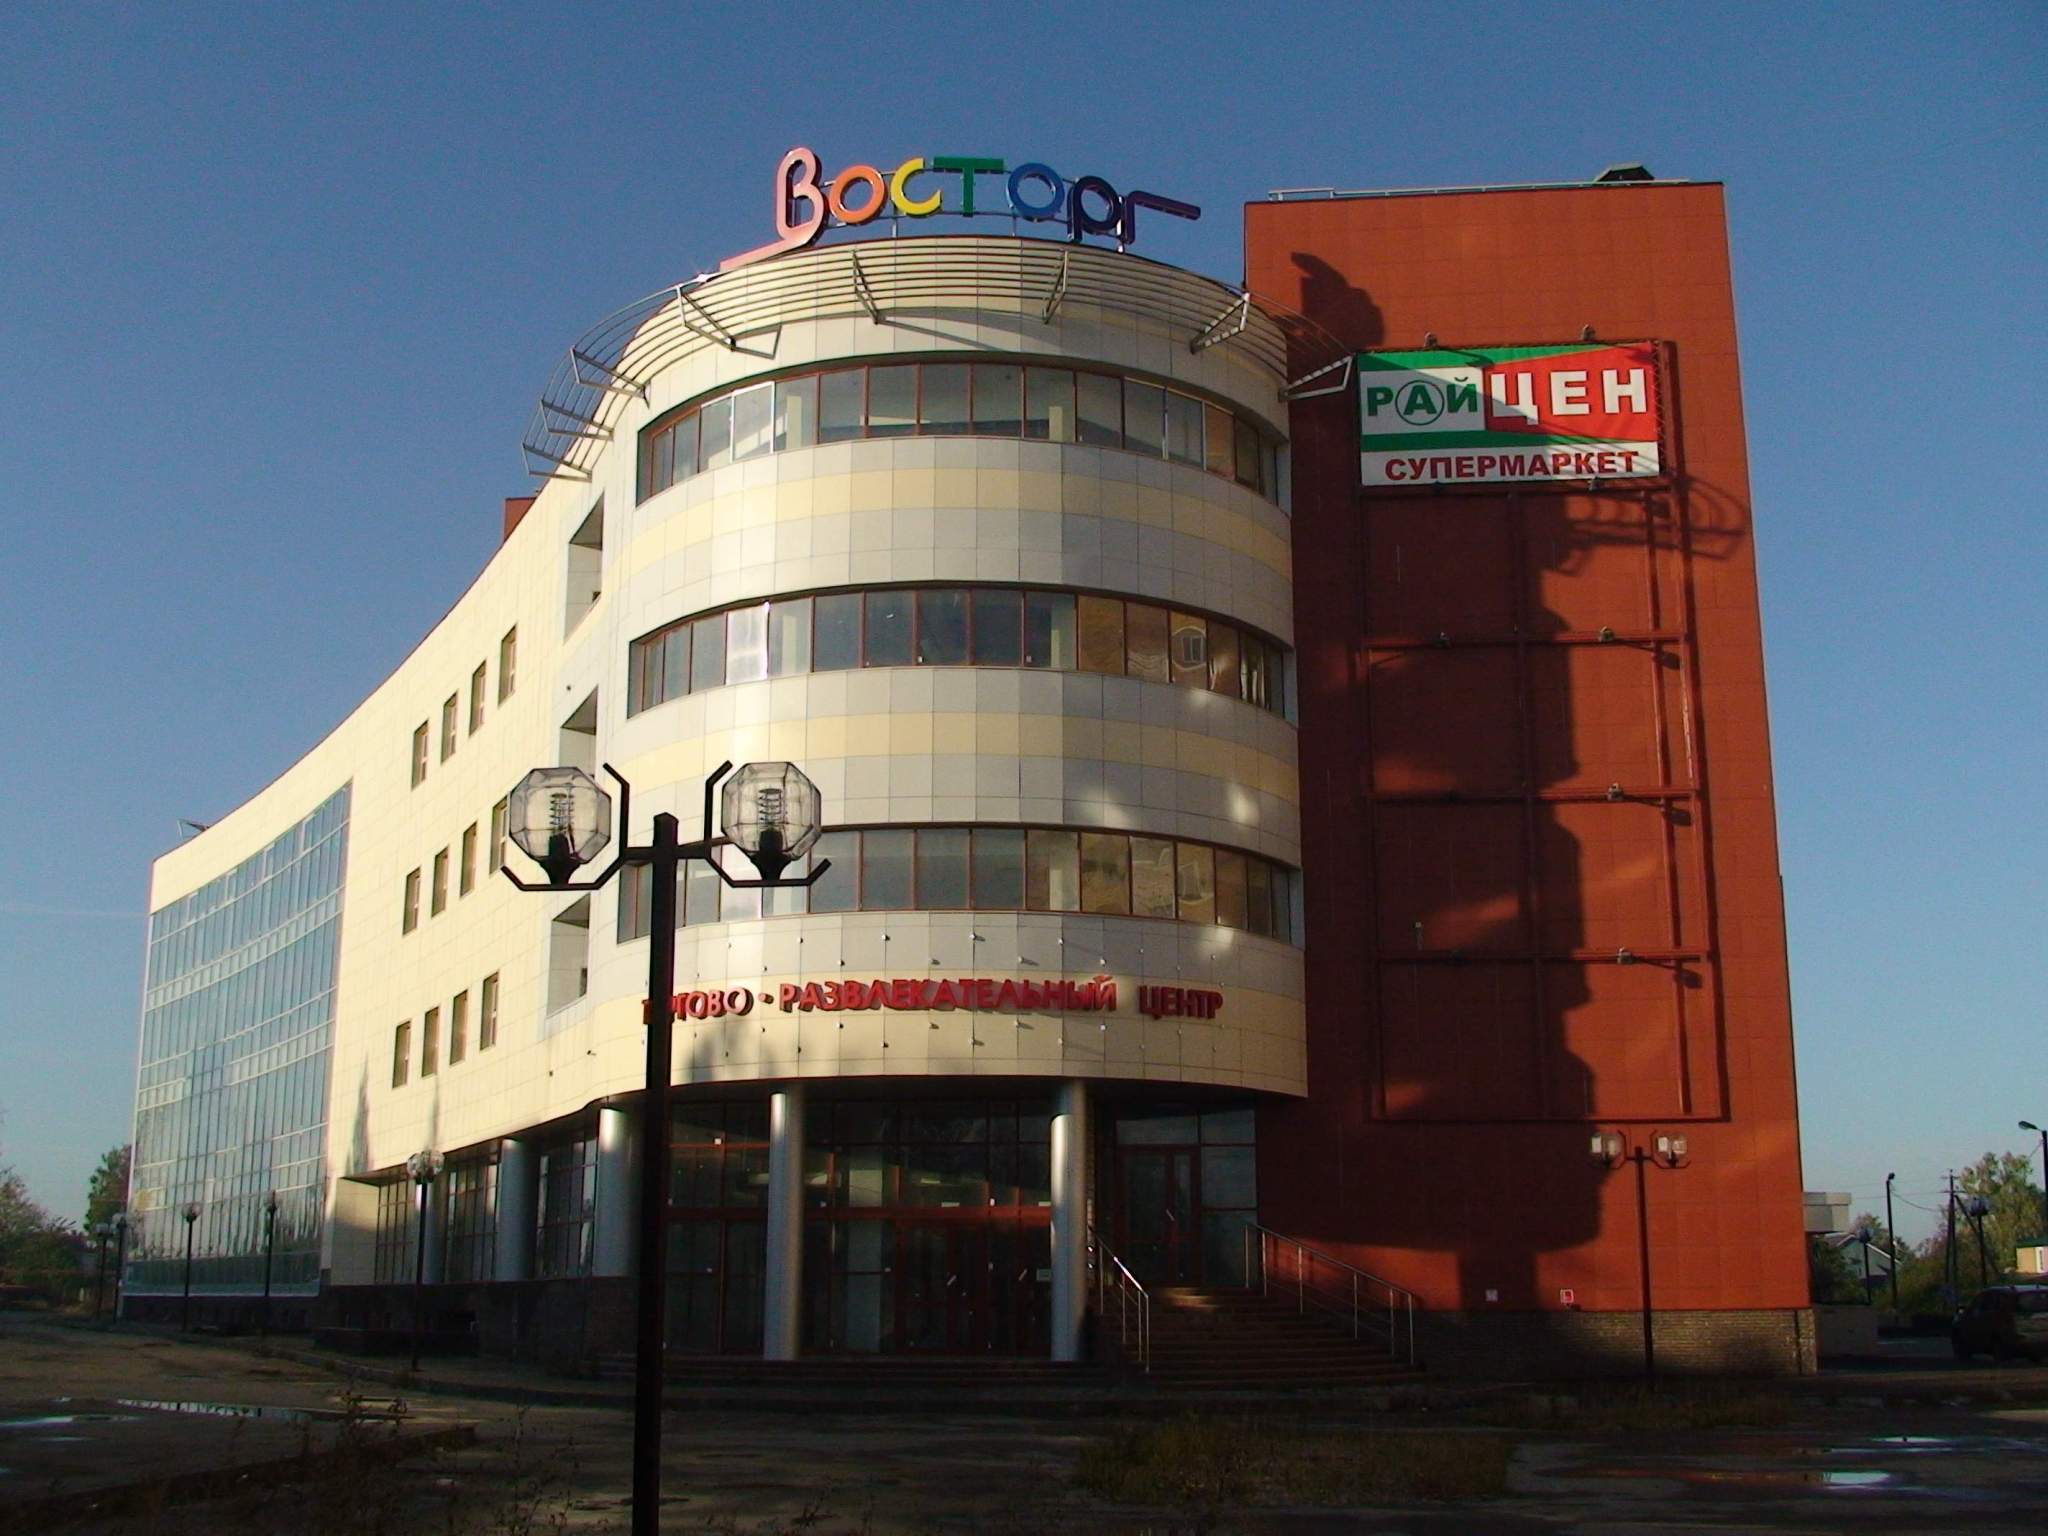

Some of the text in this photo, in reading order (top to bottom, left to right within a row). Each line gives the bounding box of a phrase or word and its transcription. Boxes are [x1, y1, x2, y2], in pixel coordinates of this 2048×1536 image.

[718, 147, 1200, 272] Восторг
[1366, 368, 1648, 425] РАЙ ЦЕН
[1385, 451, 1639, 481] СУПЕРМАРКЕТ
[1138, 985, 1224, 1021] ЦЕНТР
